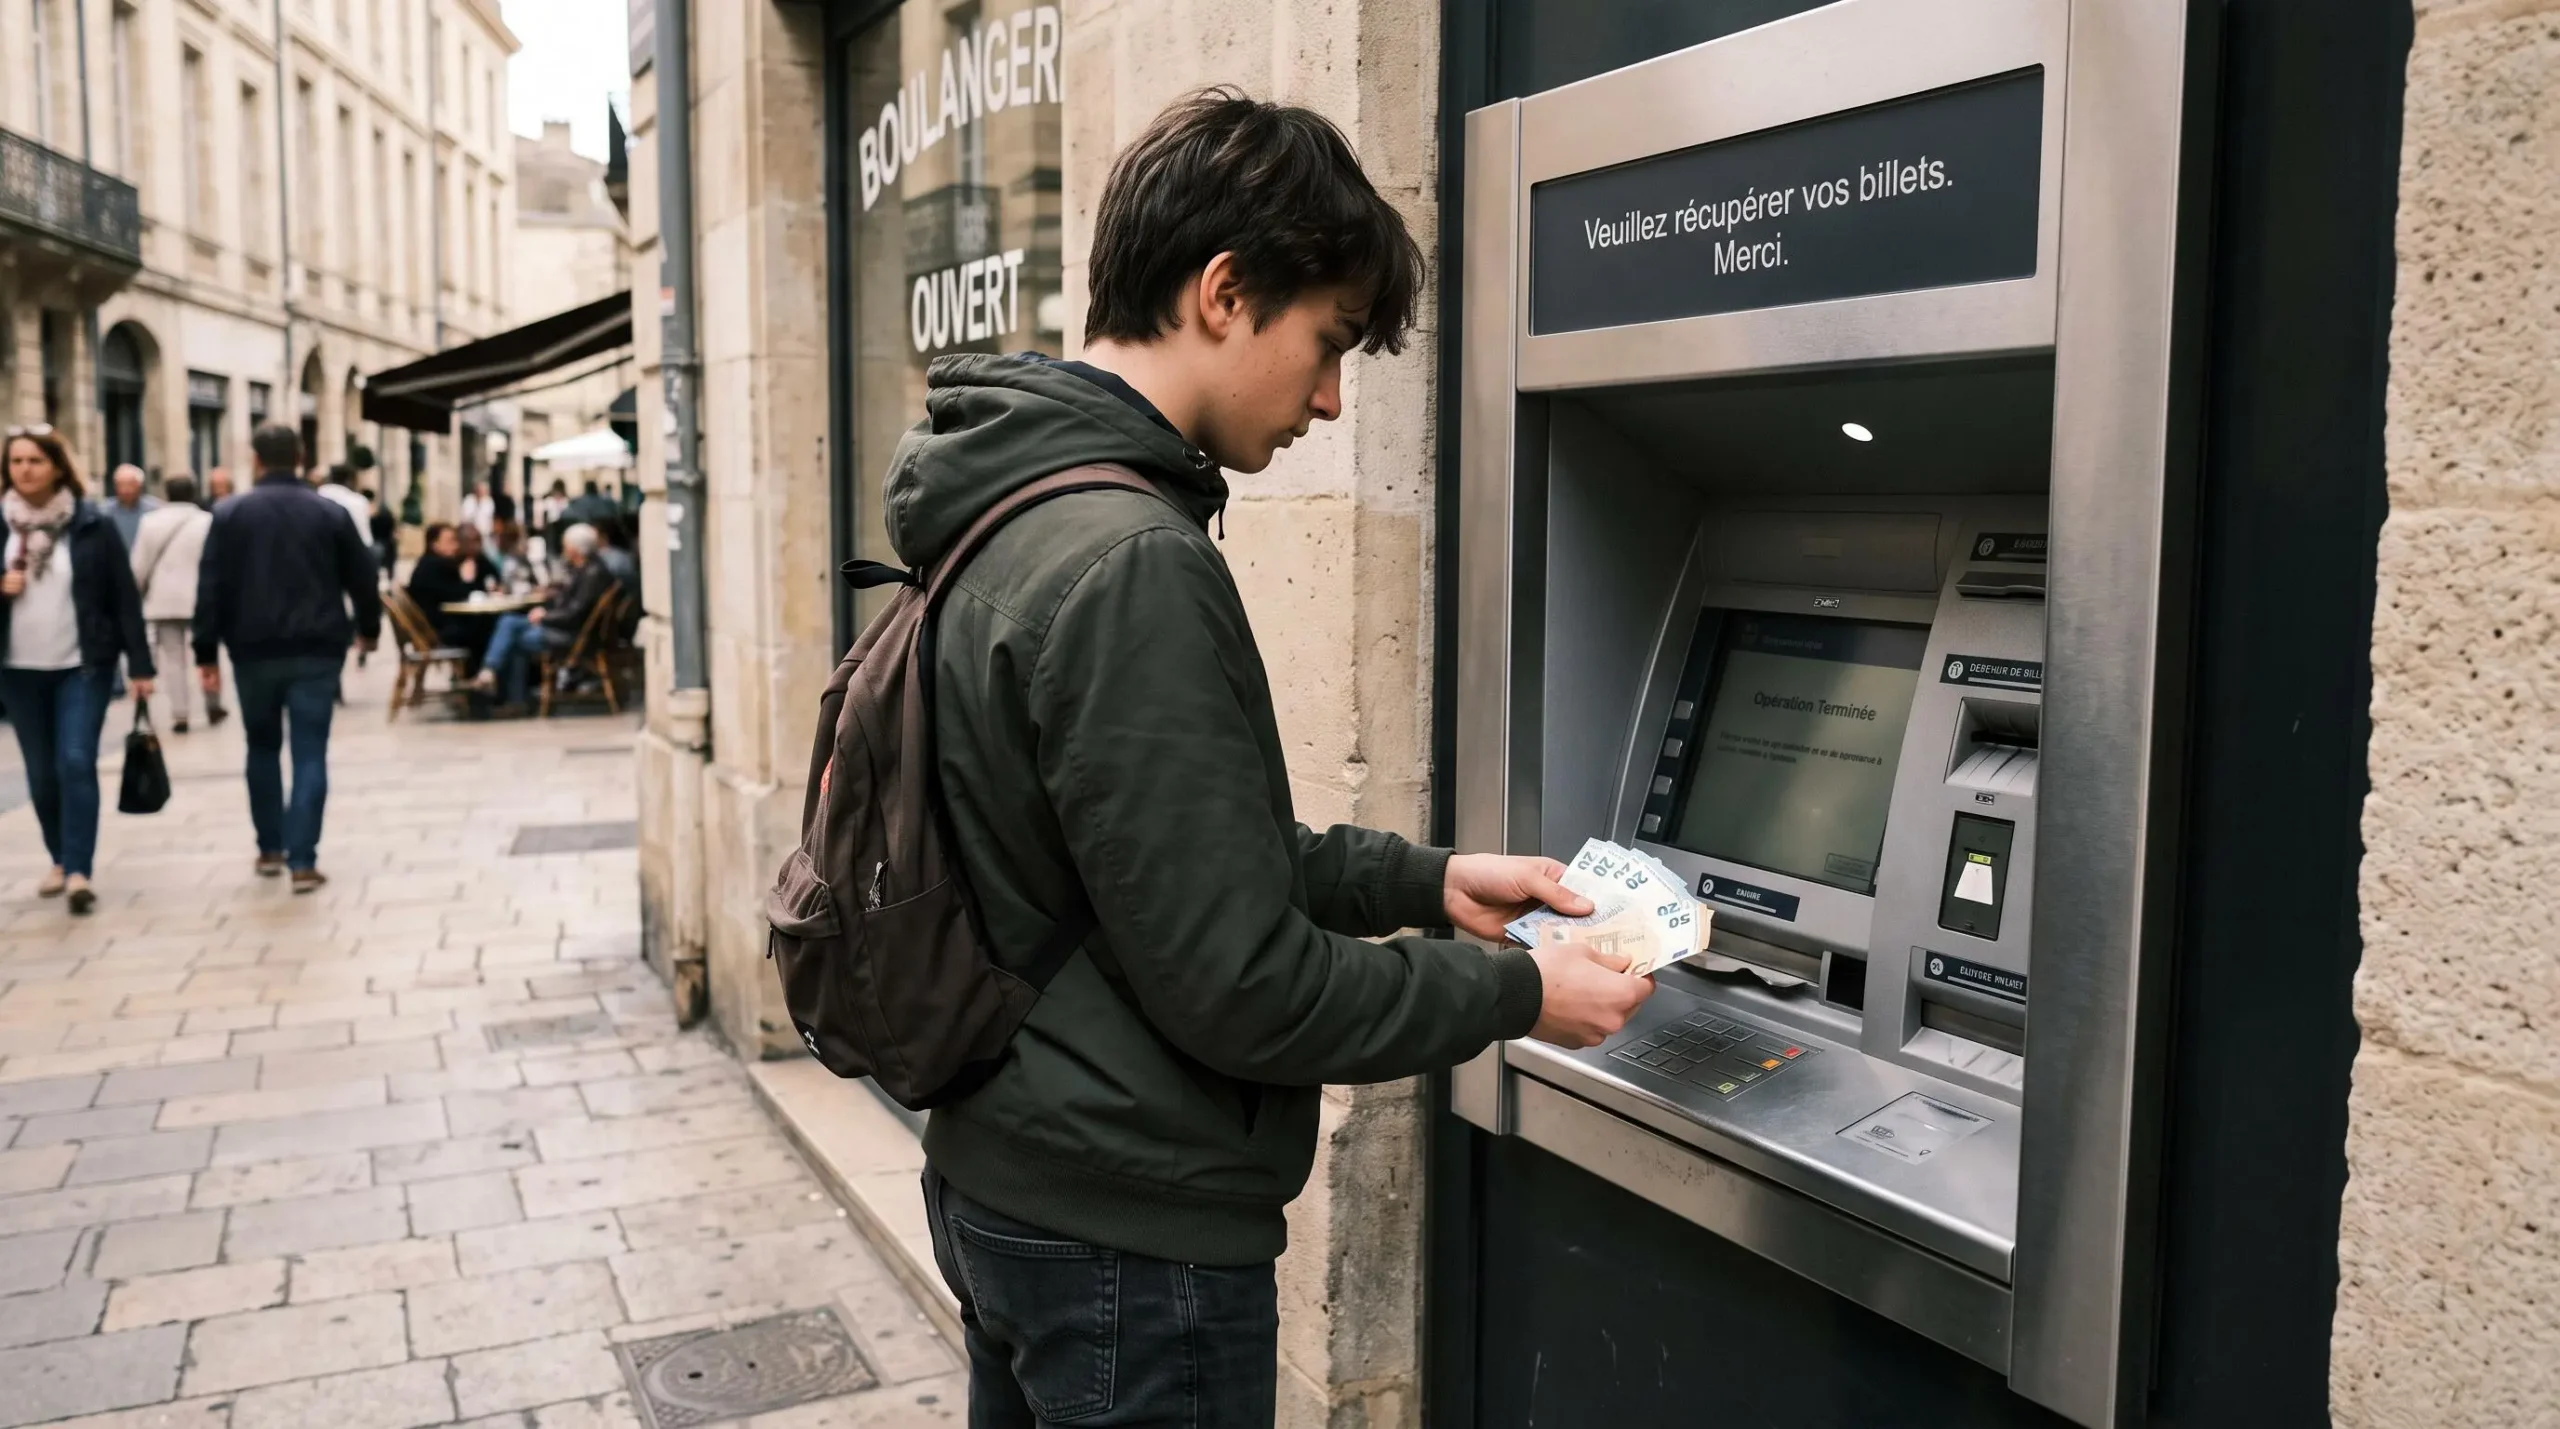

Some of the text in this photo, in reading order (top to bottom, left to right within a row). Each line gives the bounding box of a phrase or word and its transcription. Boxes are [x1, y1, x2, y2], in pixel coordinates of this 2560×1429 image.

[859, 6, 1064, 212] BOULANGER
[1584, 155, 1953, 250] Veuillez récupérer vos billets.
[1714, 232, 1789, 276] Merci.
[912, 248, 1024, 352] OUVERT
[1753, 690, 1877, 721] Opération Terminée
[1593, 856, 1615, 877] 20
[1625, 870, 1648, 890] 20
[1669, 913, 1690, 929] 50
